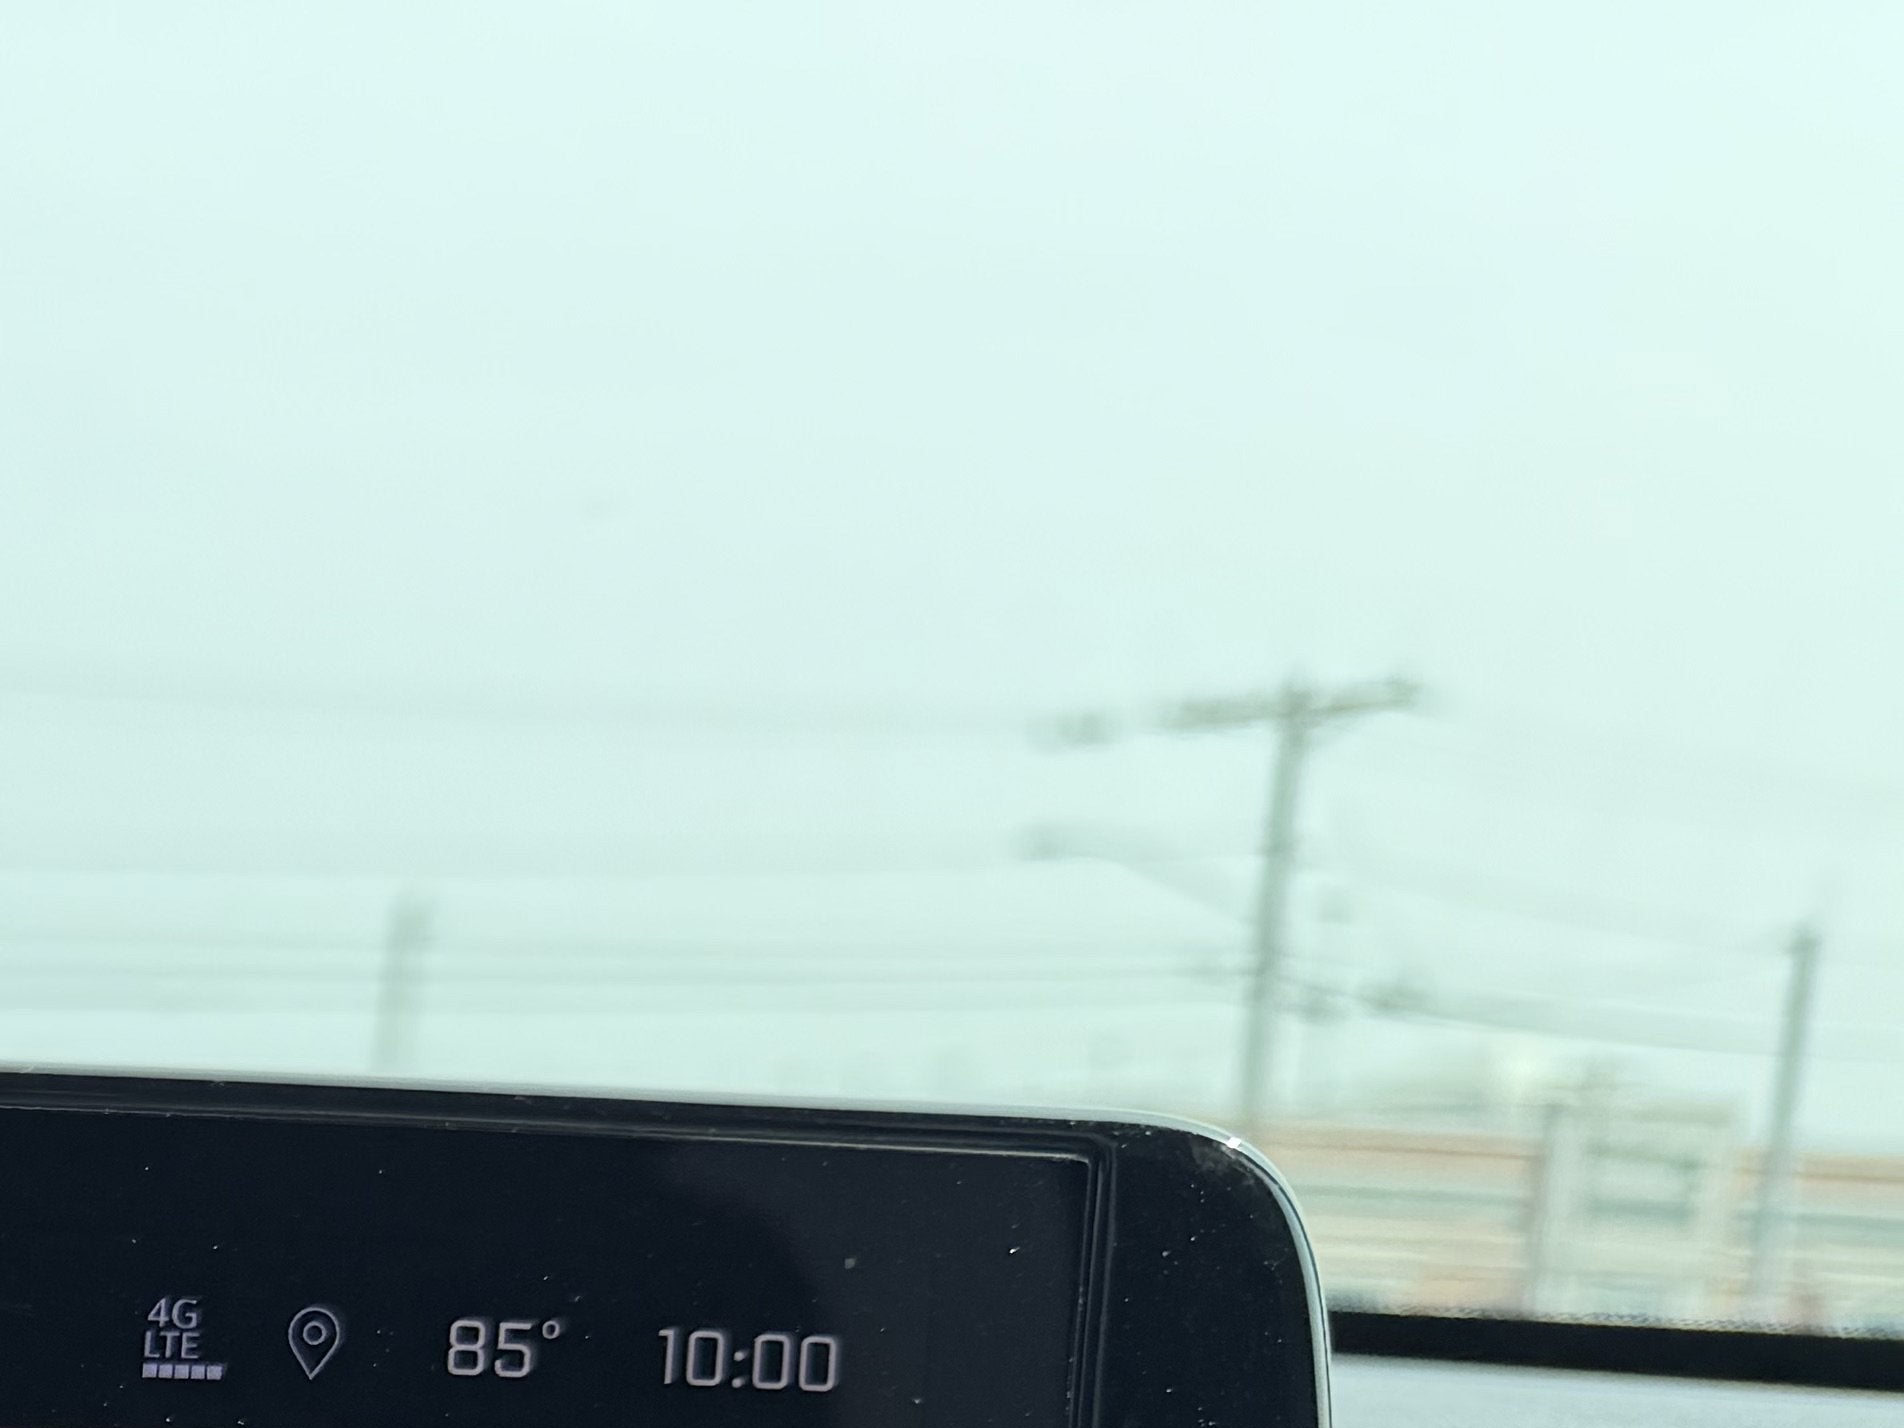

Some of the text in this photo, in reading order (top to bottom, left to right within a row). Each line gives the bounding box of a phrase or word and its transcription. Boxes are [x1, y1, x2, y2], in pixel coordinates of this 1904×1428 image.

[148, 1299, 198, 1328] 4G
[144, 1331, 199, 1358] LTE
[446, 1319, 561, 1378] 85°
[658, 1329, 839, 1393] 10:00
